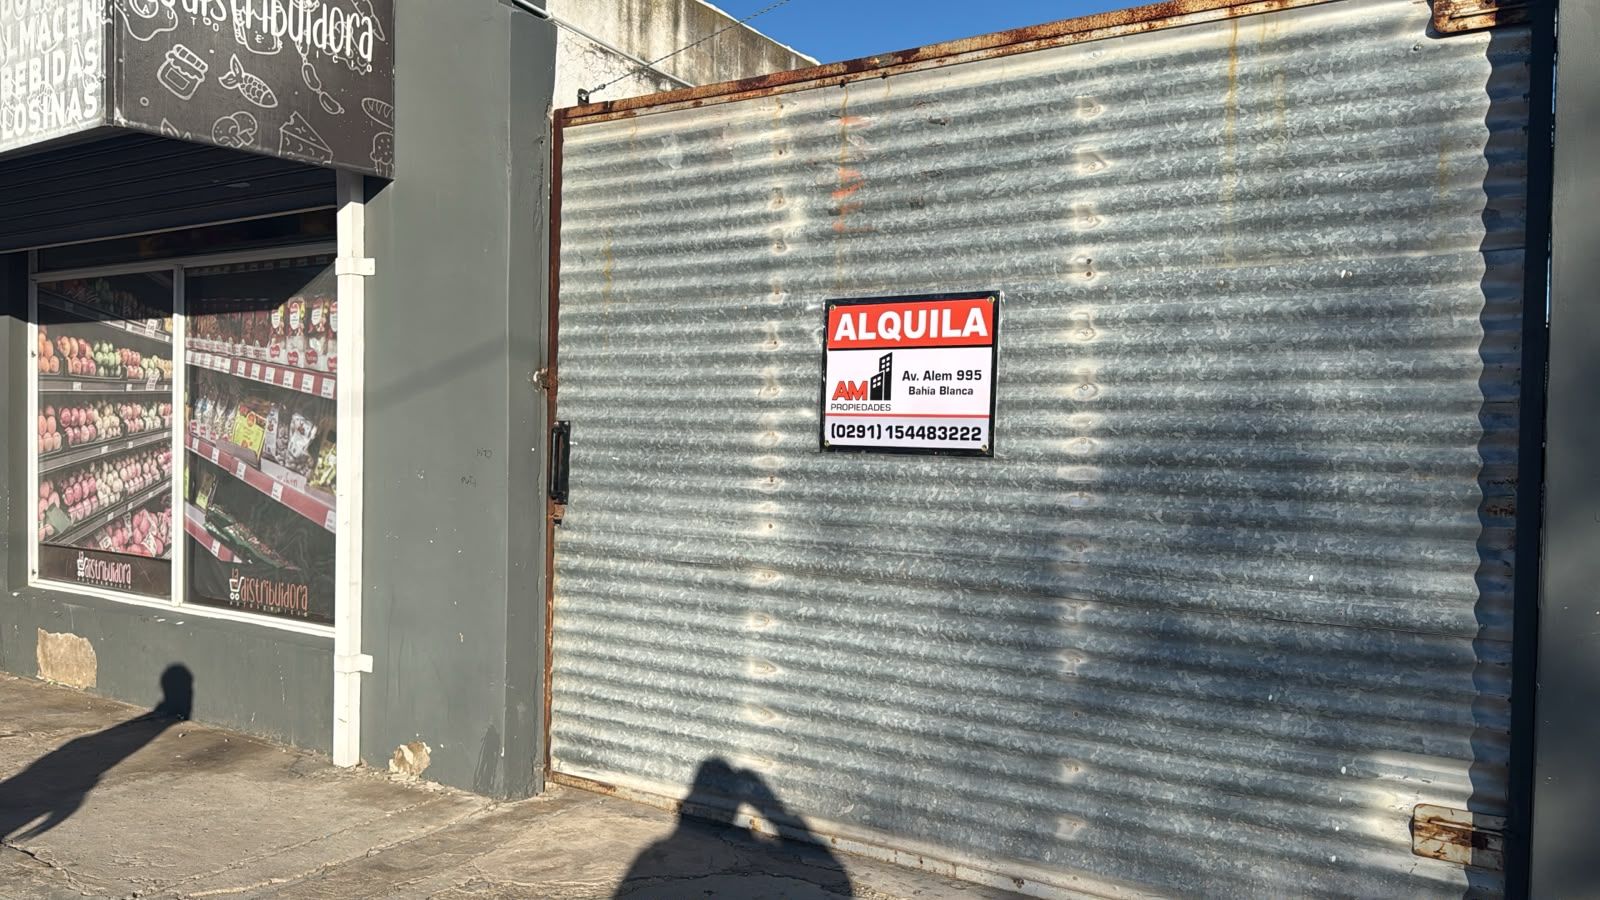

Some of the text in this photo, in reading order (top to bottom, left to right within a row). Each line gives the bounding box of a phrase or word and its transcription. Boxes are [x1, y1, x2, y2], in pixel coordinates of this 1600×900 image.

[833, 307, 989, 342] ALQUILA
[902, 369, 982, 381] Av. Alem 995
[831, 380, 868, 401] AM
[939, 385, 974, 396] Blanca
[830, 403, 891, 412] PROPIEDADES
[831, 422, 982, 441] (0291) 154483222
[240, 576, 308, 611] distribuidora
